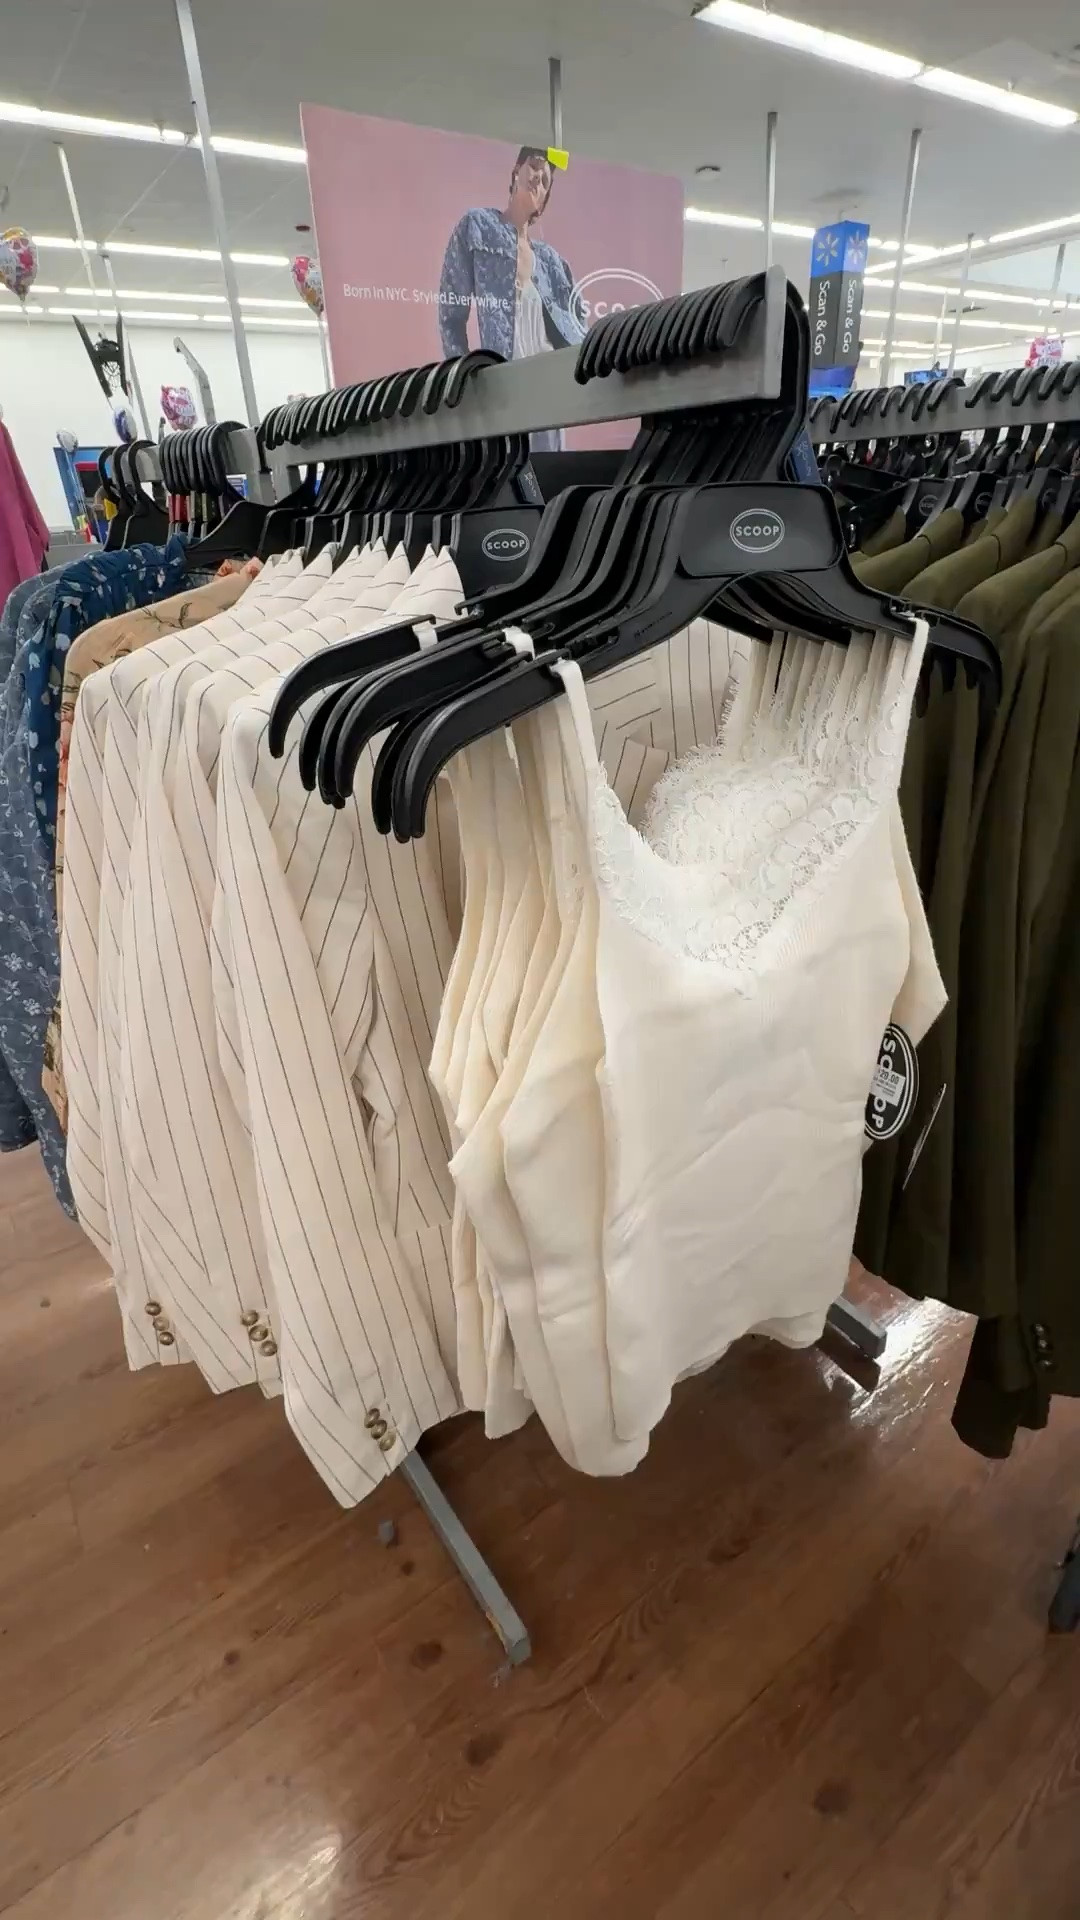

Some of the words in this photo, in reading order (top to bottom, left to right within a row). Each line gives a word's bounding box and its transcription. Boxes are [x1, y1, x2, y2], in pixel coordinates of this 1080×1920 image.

[343, 283, 371, 299] Born
[412, 288, 447, 305] Styled
[818, 280, 830, 317] Scan
[846, 279, 857, 314] Scan
[816, 319, 827, 331] &
[845, 317, 854, 329] &
[814, 333, 826, 356] Go
[843, 331, 852, 353] Go
[735, 526, 780, 537] SCOOP
[486, 539, 526, 551] SCOOP
[871, 1037, 897, 1129] SCOP
